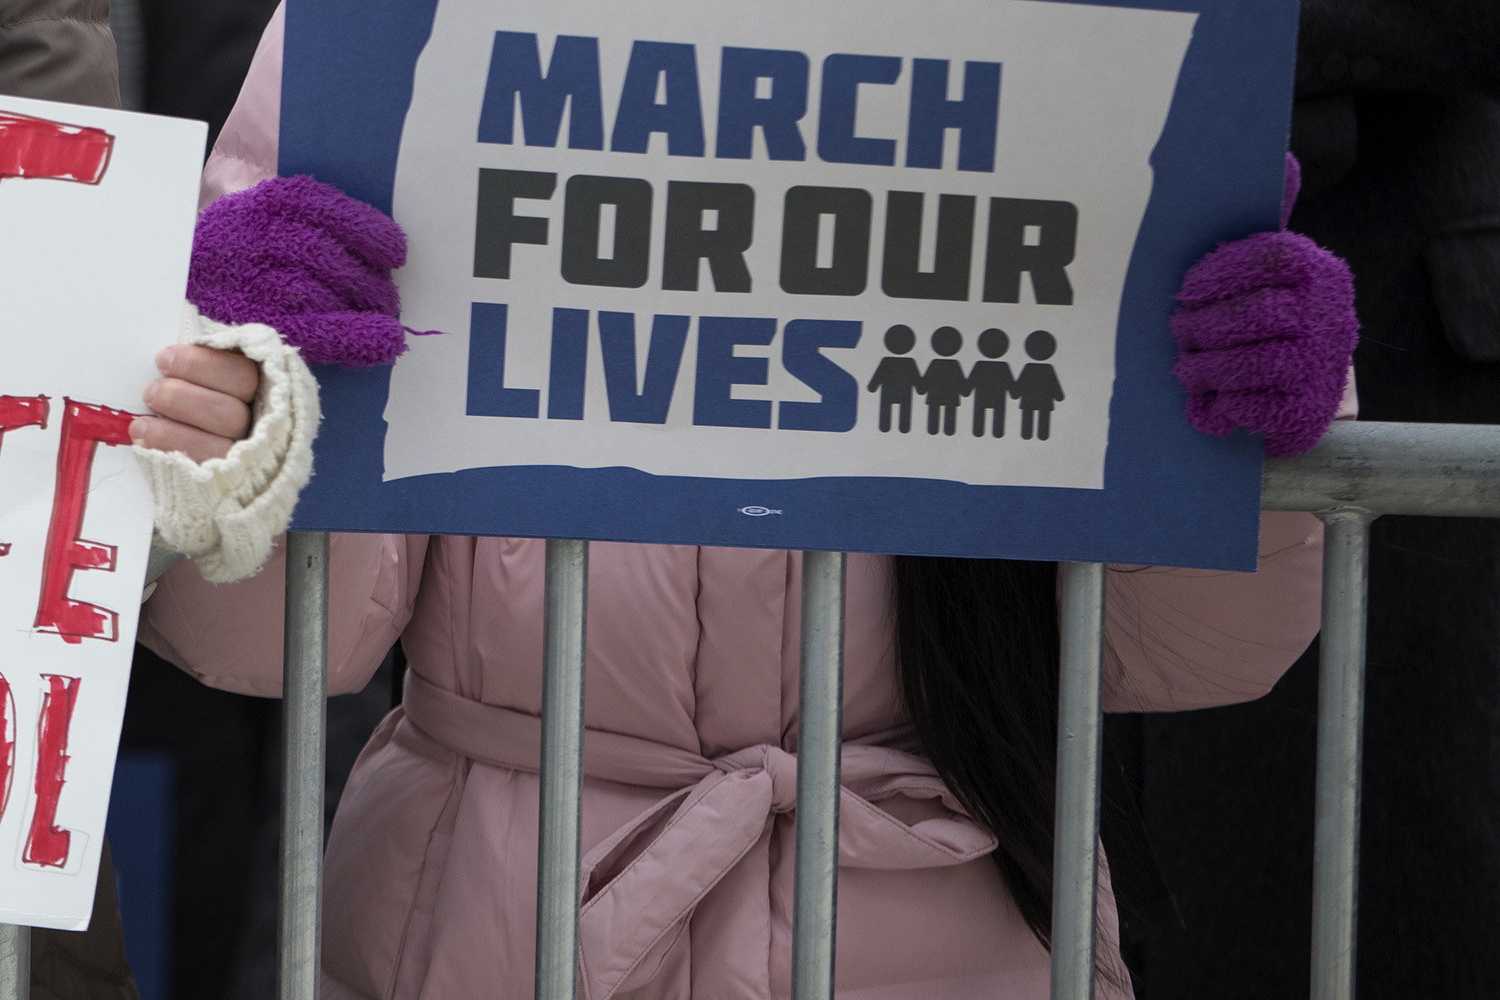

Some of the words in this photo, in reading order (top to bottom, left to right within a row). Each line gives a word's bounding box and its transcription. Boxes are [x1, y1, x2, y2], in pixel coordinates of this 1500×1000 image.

[476, 29, 1003, 174] MARCH
[472, 166, 755, 295] FOR
[777, 184, 1079, 306] OUR
[465, 301, 864, 434] LIVES
